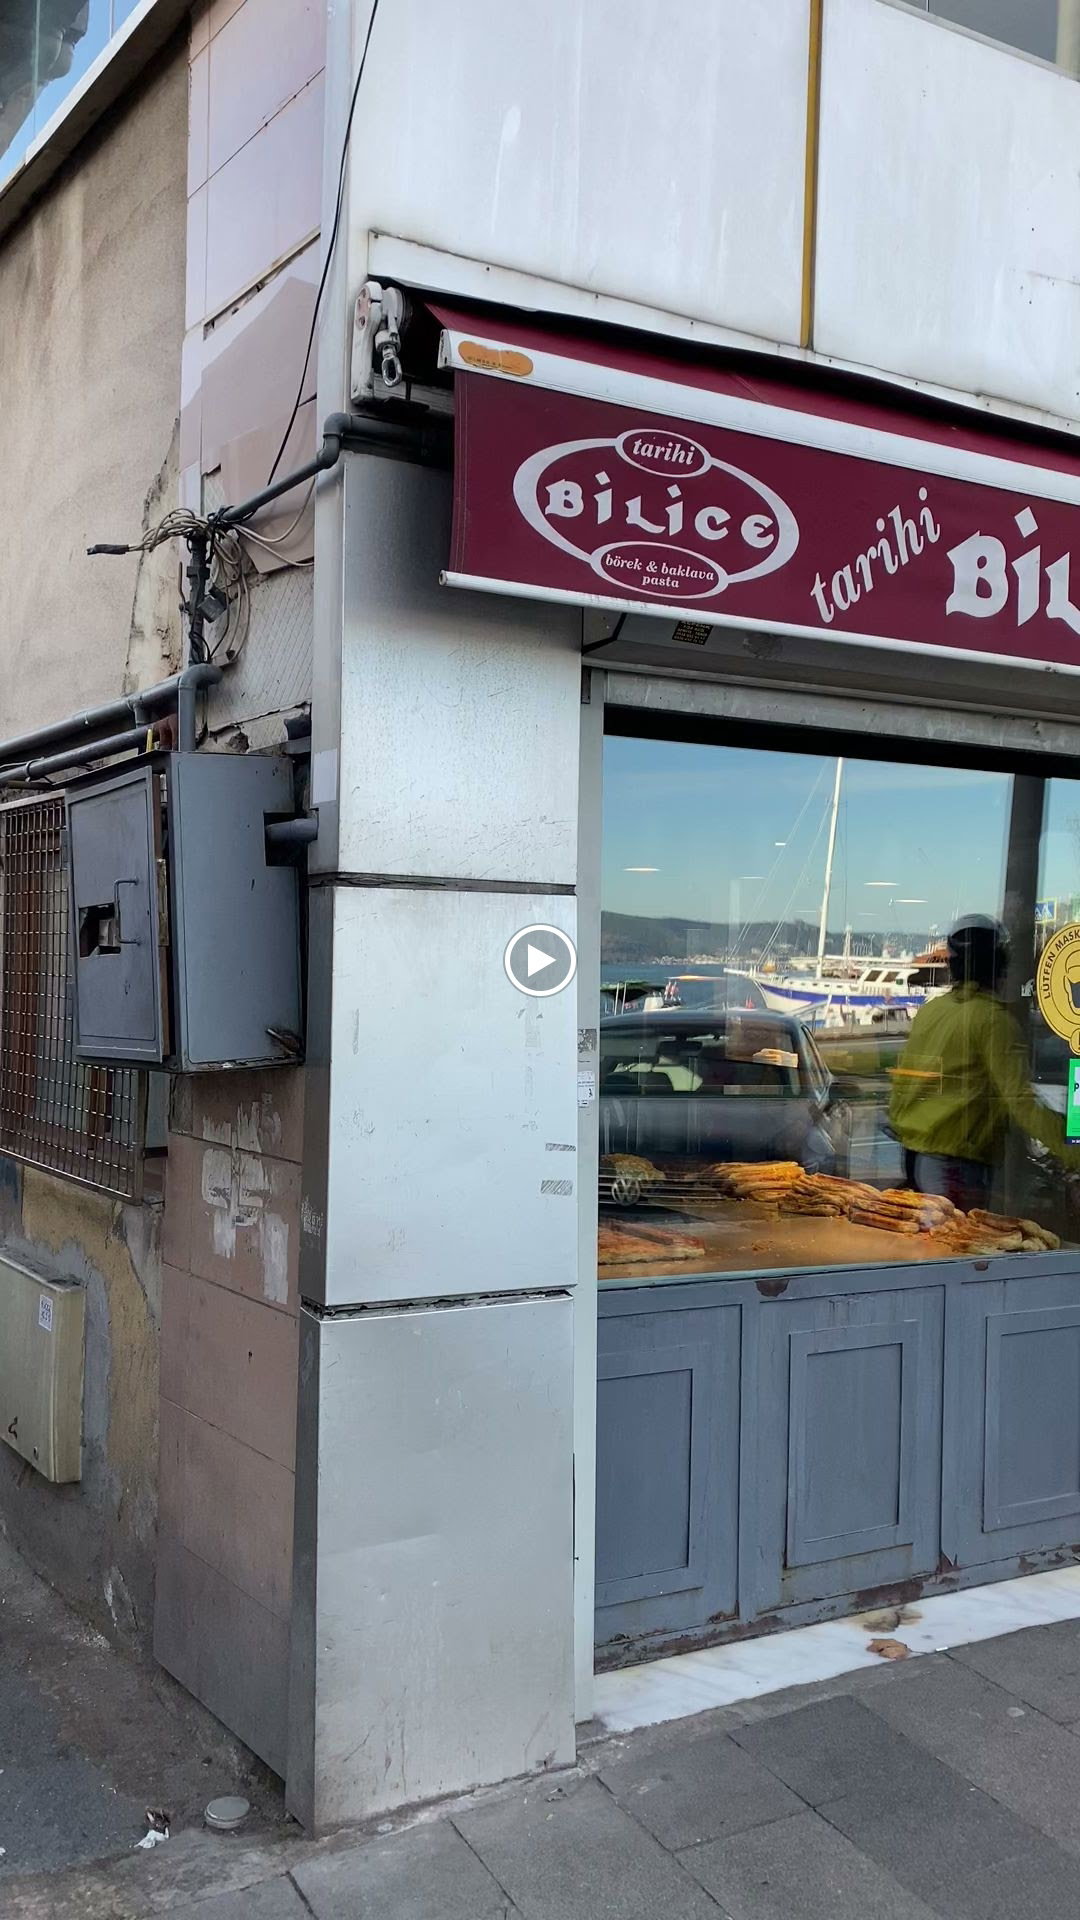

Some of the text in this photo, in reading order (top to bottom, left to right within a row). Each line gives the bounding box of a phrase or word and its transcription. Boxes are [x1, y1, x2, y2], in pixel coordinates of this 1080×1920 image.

[632, 438, 695, 465] tarihi
[605, 554, 714, 581] börek & baklava
[810, 486, 940, 623] tarihi
[642, 575, 680, 588] pasta
